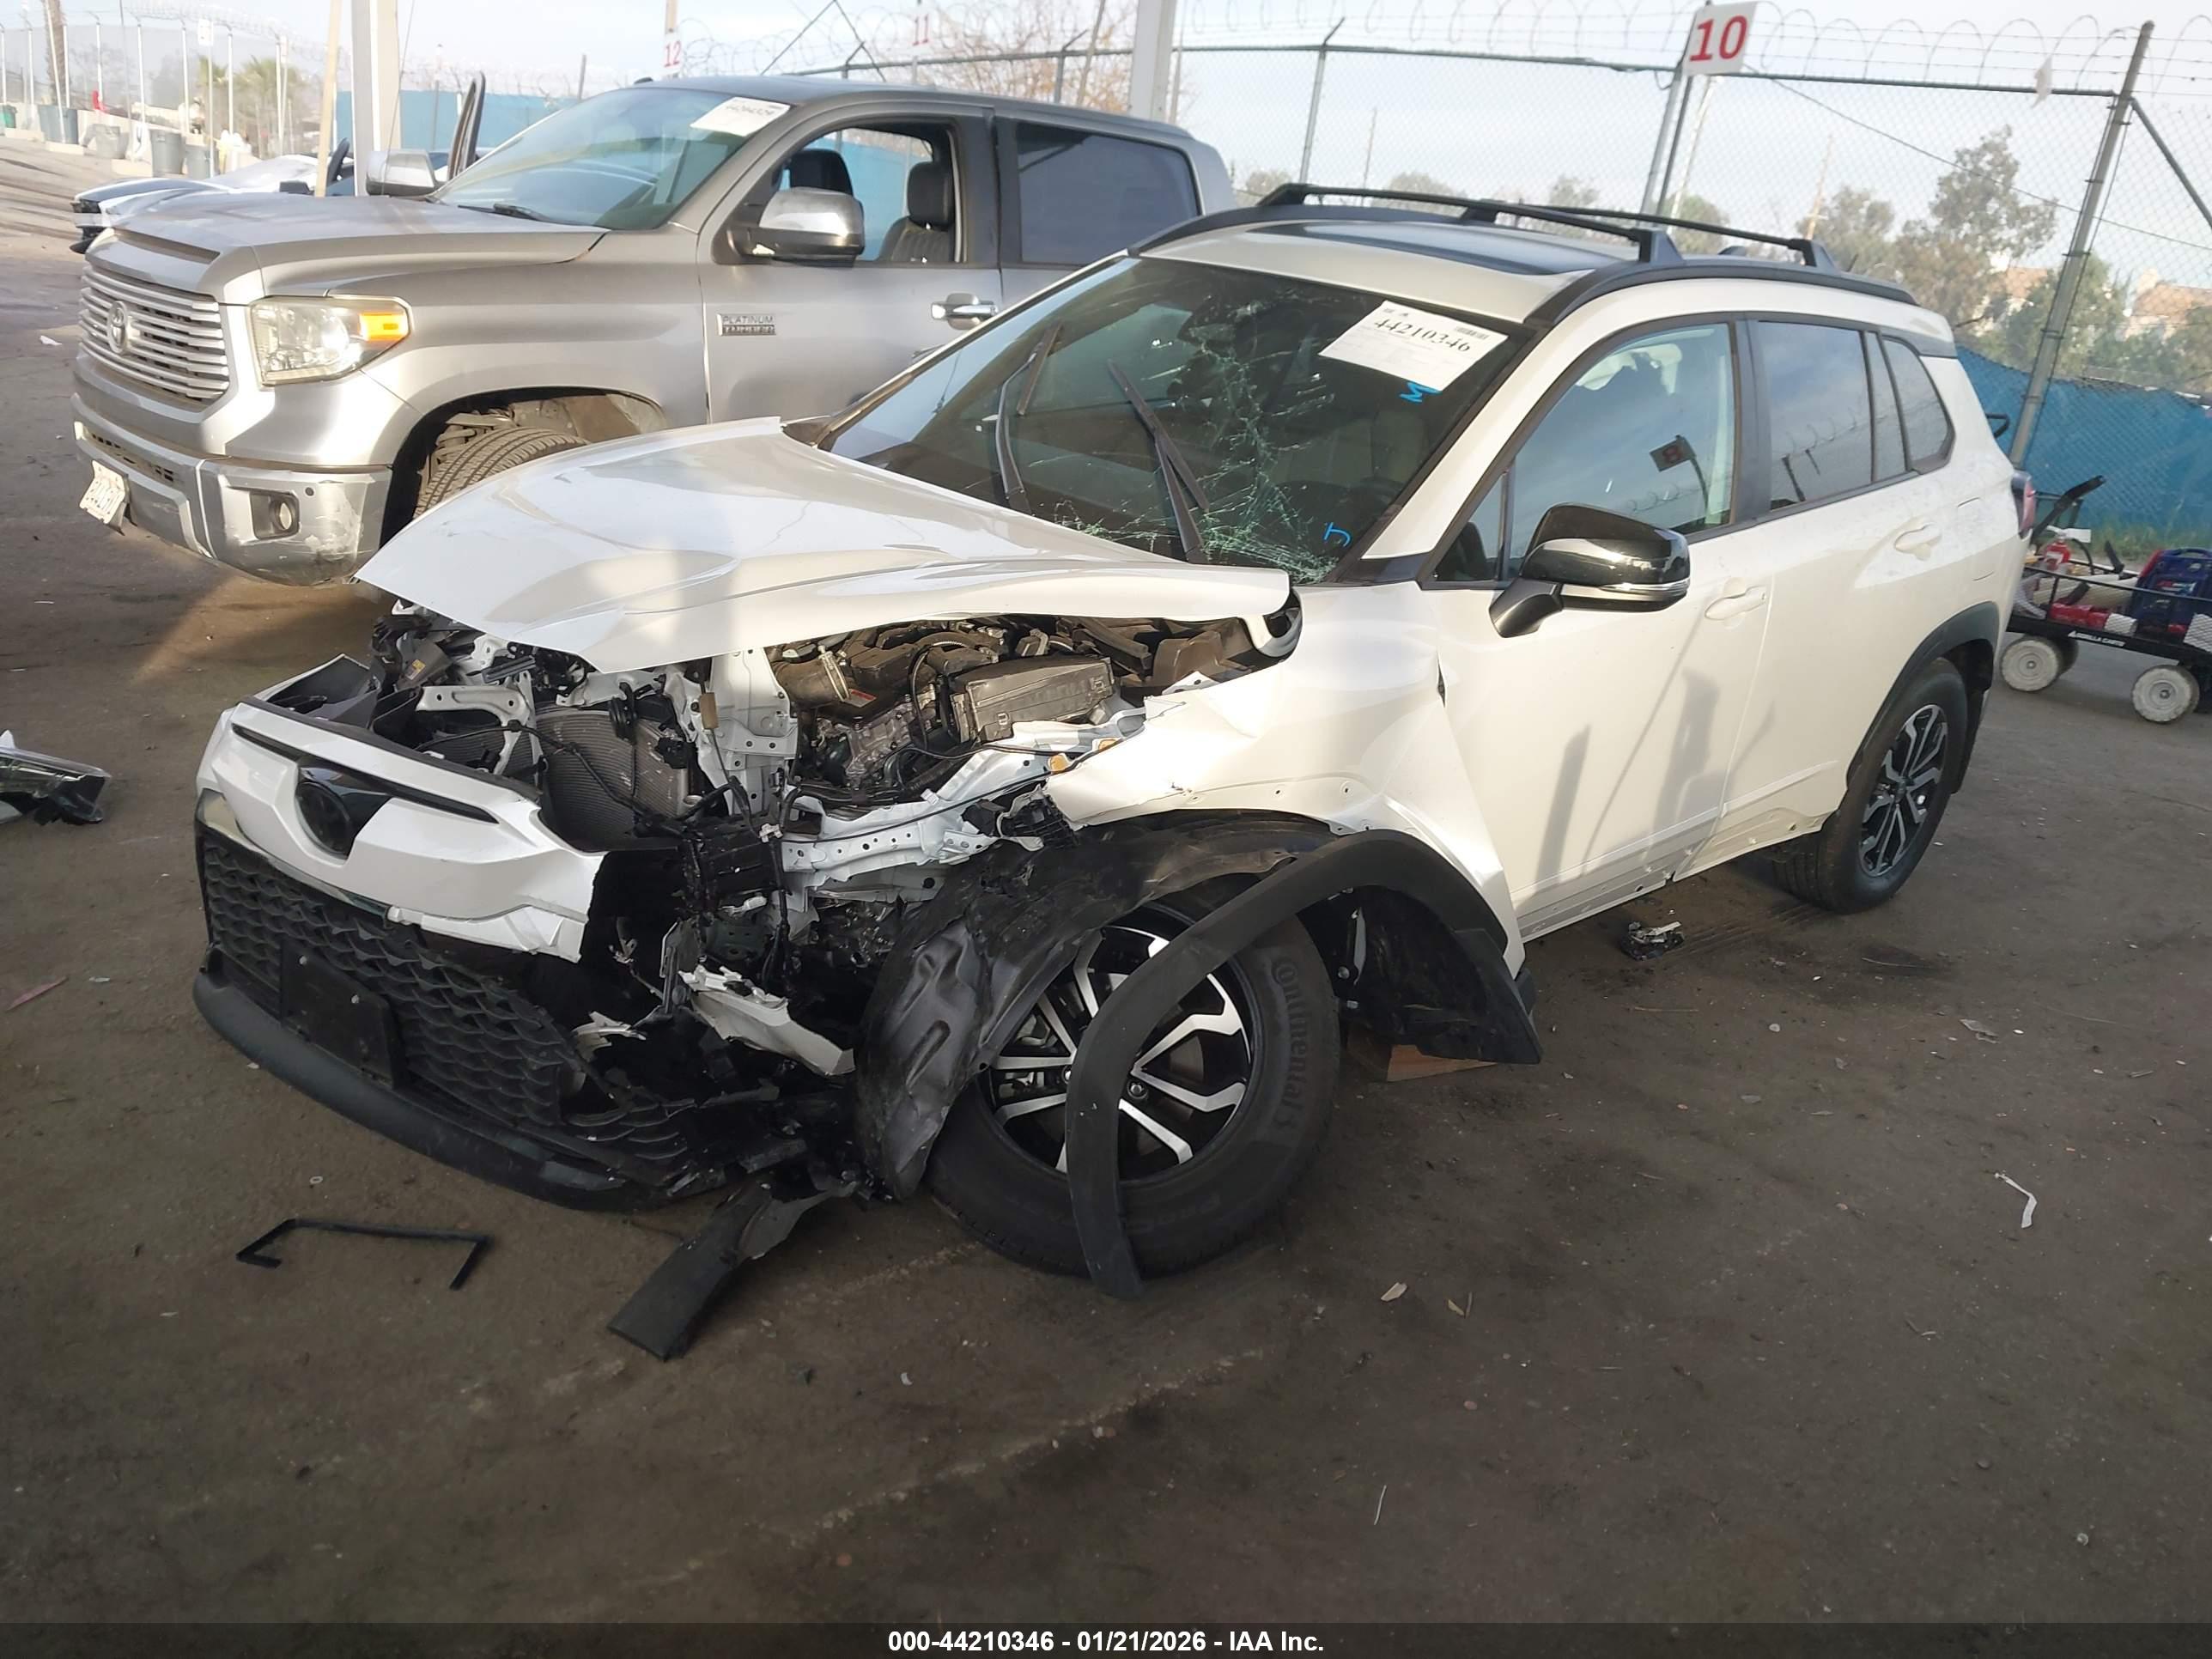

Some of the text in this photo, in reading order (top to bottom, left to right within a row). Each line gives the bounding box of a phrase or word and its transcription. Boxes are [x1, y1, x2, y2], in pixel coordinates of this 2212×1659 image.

[911, 15, 930, 46] 11
[1689, 15, 1747, 62] 10
[664, 40, 681, 68] 12
[1374, 319, 1471, 352] 44210346
